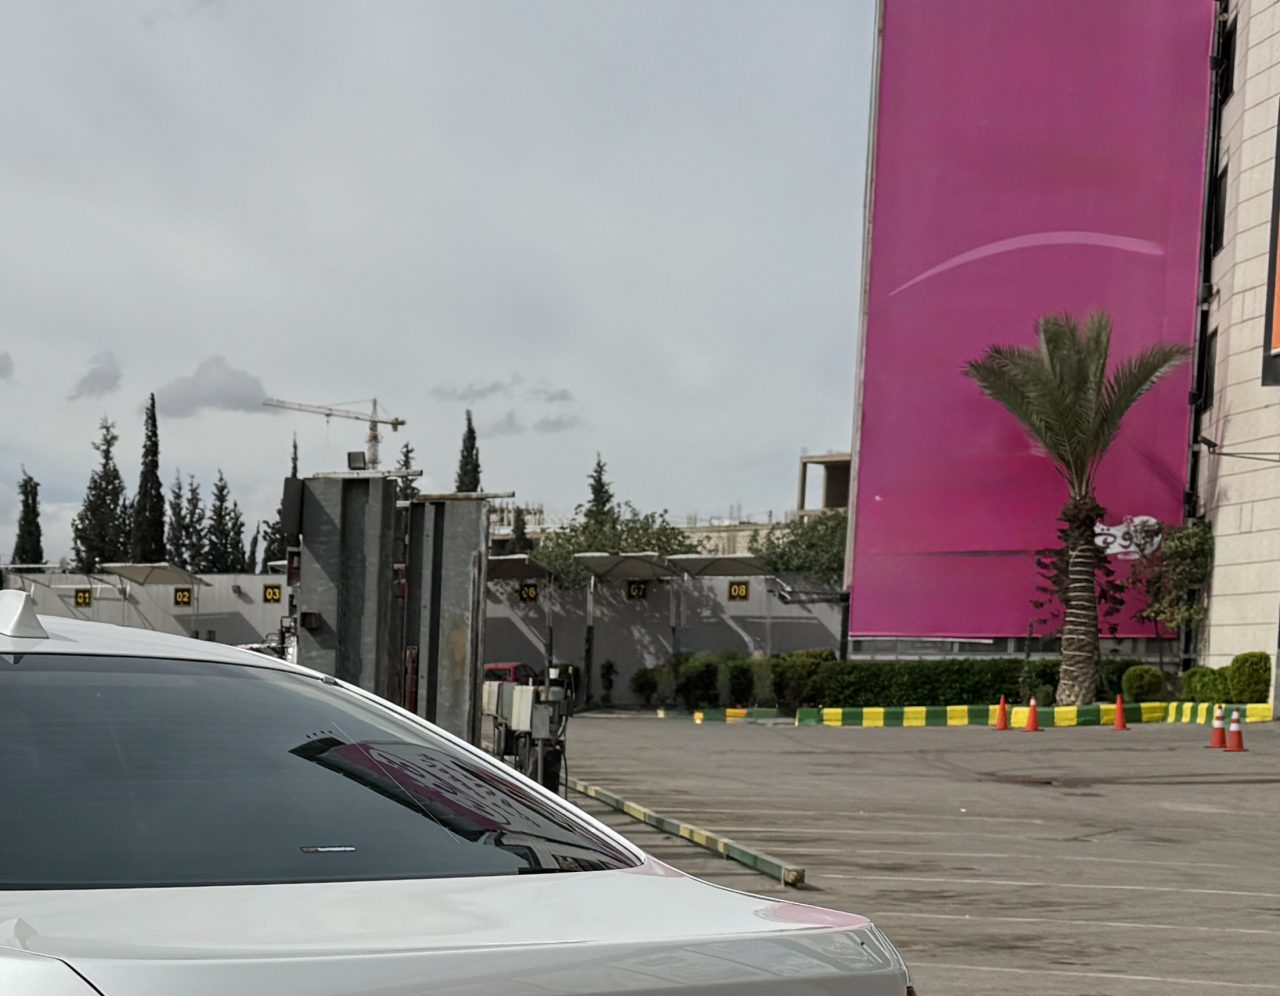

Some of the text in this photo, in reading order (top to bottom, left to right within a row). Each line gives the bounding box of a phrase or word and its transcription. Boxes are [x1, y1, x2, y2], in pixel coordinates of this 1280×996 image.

[266, 588, 280, 600] 03
[730, 584, 746, 597] 08
[77, 592, 89, 603] 01
[176, 591, 189, 602] 02
